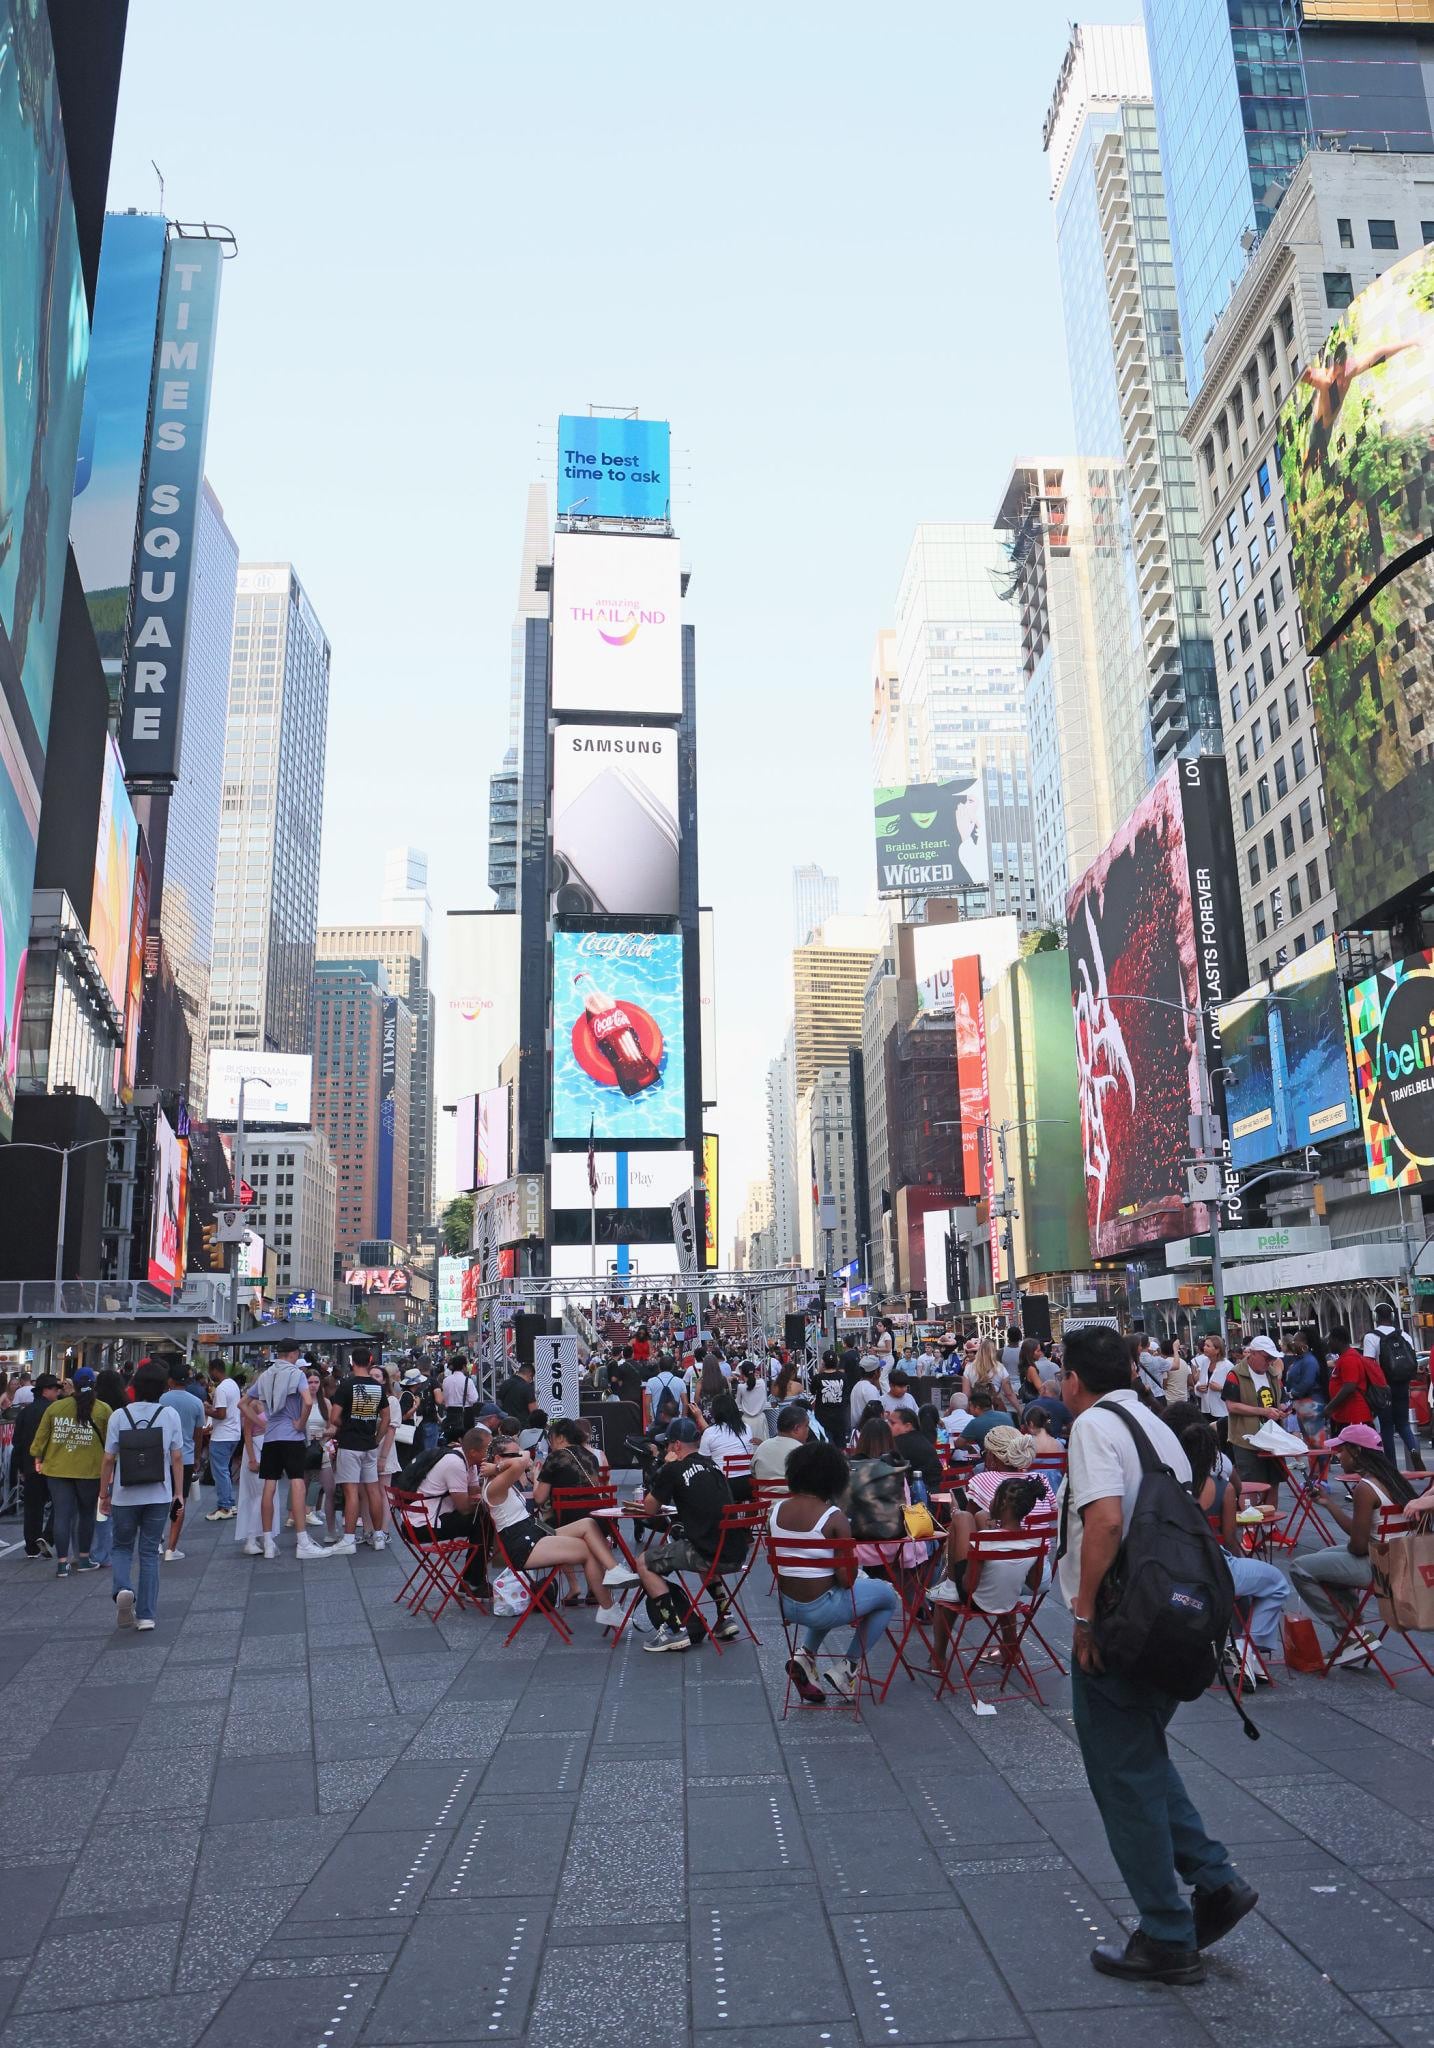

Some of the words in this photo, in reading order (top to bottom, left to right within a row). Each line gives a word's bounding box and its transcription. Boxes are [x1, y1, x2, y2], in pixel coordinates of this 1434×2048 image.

[156, 263, 202, 451] TIMES
[565, 450, 597, 465] The
[601, 452, 639, 467] best
[564, 465, 603, 480] time
[608, 468, 626, 482] to
[631, 470, 661, 484] ask
[595, 598, 640, 610] amazing
[132, 485, 180, 741] SQUARE
[570, 607, 666, 625] THAILAND
[572, 738, 663, 755] SAMSUNG
[885, 840, 919, 853] Brains.
[920, 839, 951, 850] Heart.
[897, 850, 939, 861] Courage.
[1197, 868, 1217, 944] FOREVER
[1204, 949, 1222, 1001] LASTS
[629, 1171, 654, 1188] Play
[550, 1342, 563, 1401] TSQ
[54, 1426, 93, 1434] CALIFORNIA
